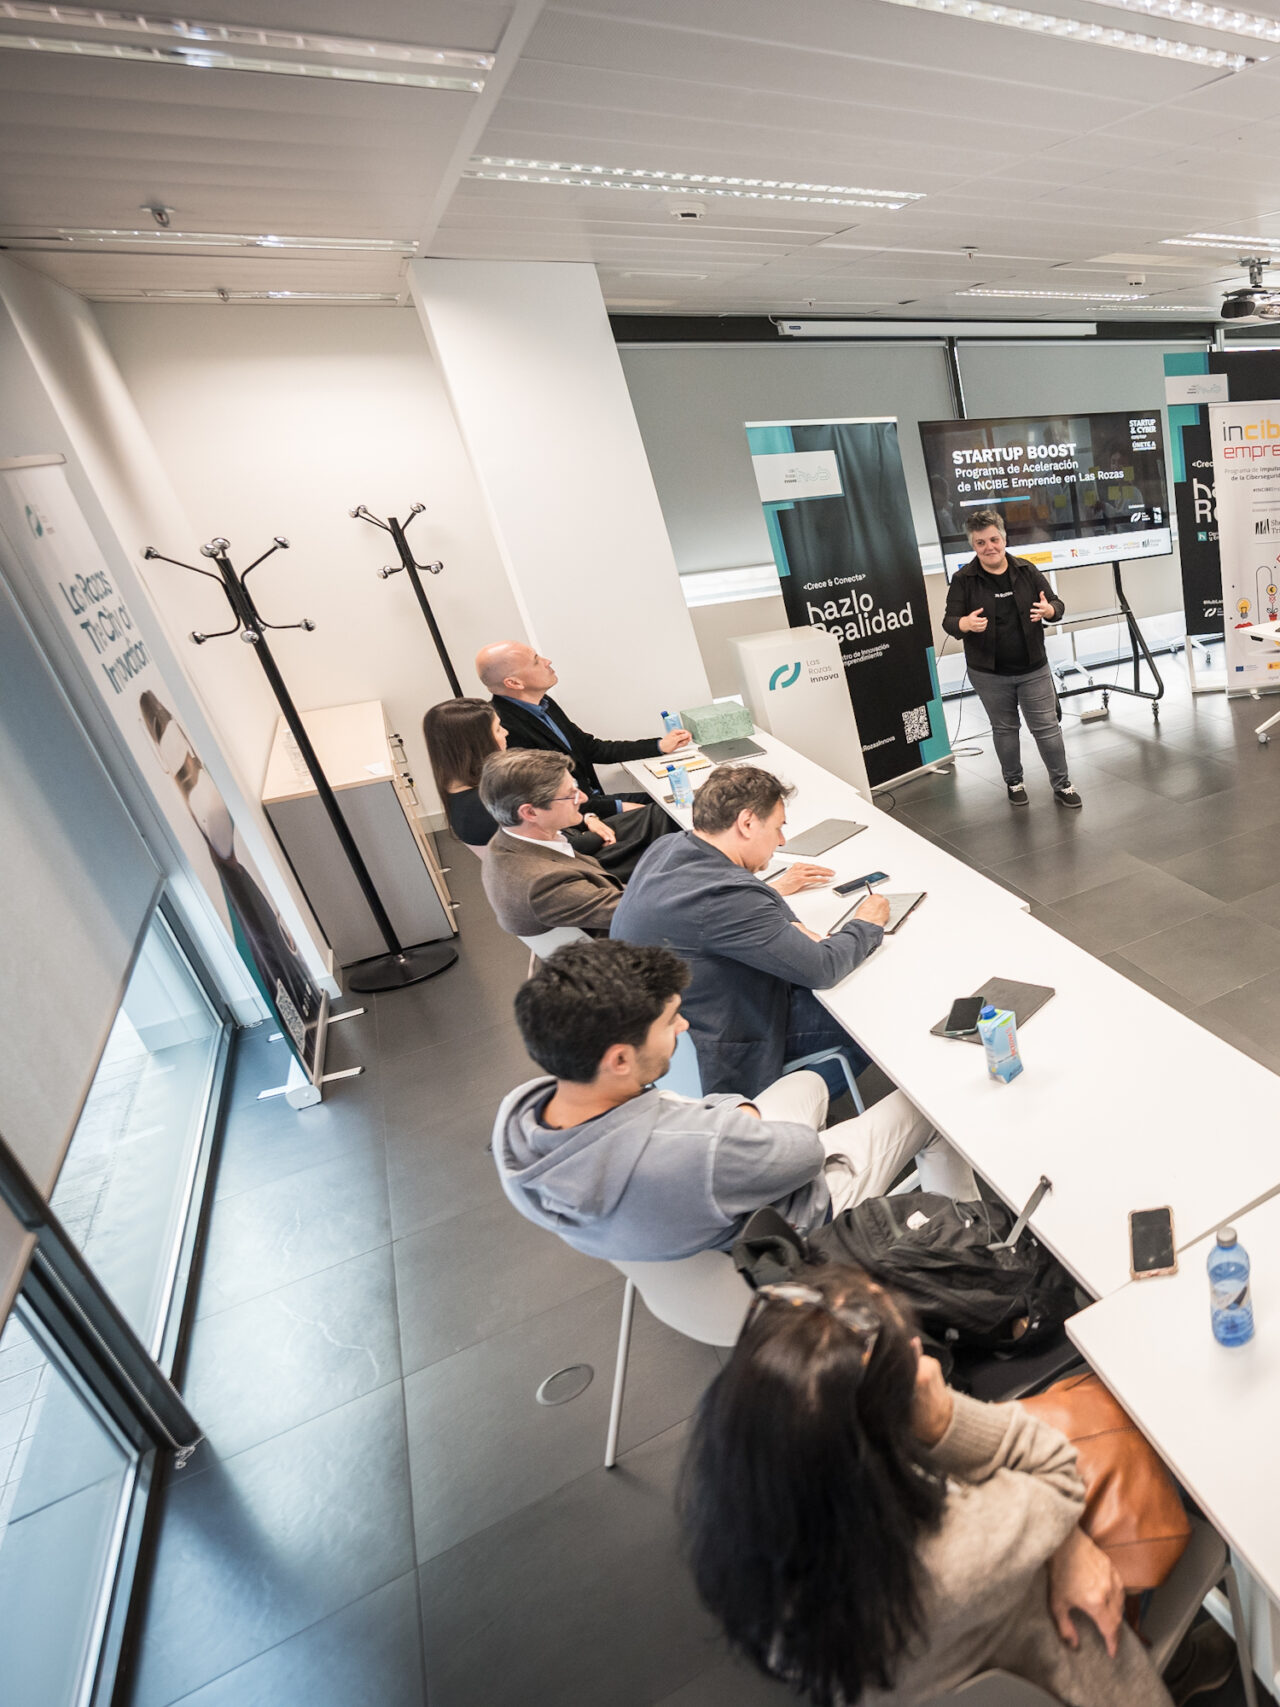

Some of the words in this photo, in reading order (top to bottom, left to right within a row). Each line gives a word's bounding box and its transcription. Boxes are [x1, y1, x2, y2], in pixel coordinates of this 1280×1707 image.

[1128, 418, 1156, 428] STARTUP
[1136, 425, 1157, 434] CYBER
[952, 446, 1023, 465] STARTUP
[1027, 443, 1077, 460] BOOST
[955, 466, 1005, 480] Programa
[1007, 463, 1020, 474] de
[1022, 460, 1079, 473] Aceleración
[957, 481, 972, 493] de
[974, 477, 1010, 491] INCIBE
[1012, 474, 1062, 489] Emprende
[1064, 474, 1077, 483] en
[1079, 471, 1096, 482] Las
[1097, 469, 1125, 480] Rozas
[803, 579, 827, 591] <Crece
[827, 578, 833, 587] &
[833, 573, 867, 586] Conecta>
[806, 589, 874, 625] hazlo
[860, 643, 890, 656] Innovación
[806, 659, 821, 667] Las
[808, 666, 833, 675] Rozas
[810, 672, 840, 683] Innova
